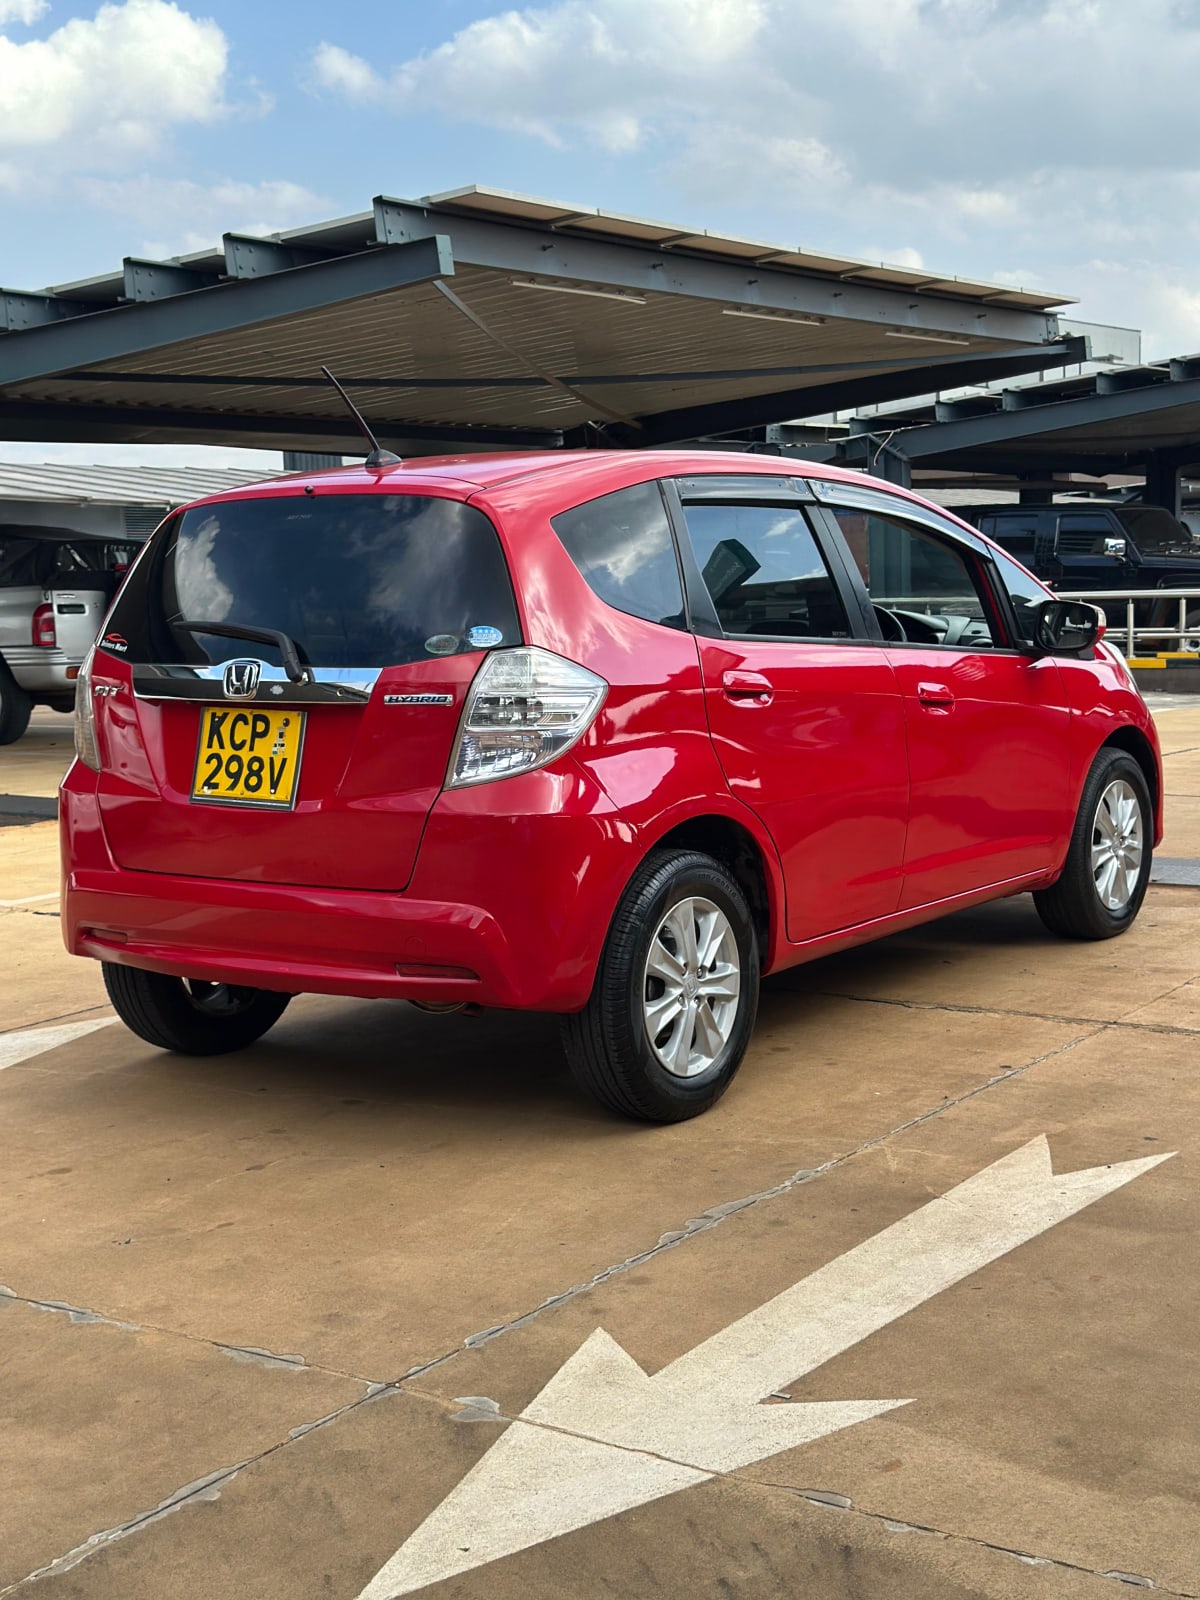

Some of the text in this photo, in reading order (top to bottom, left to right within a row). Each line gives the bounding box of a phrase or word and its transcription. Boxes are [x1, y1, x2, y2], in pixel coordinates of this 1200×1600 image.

[387, 695, 449, 704] HYBRID
[206, 711, 271, 752] KCP
[201, 752, 289, 795] 298V
